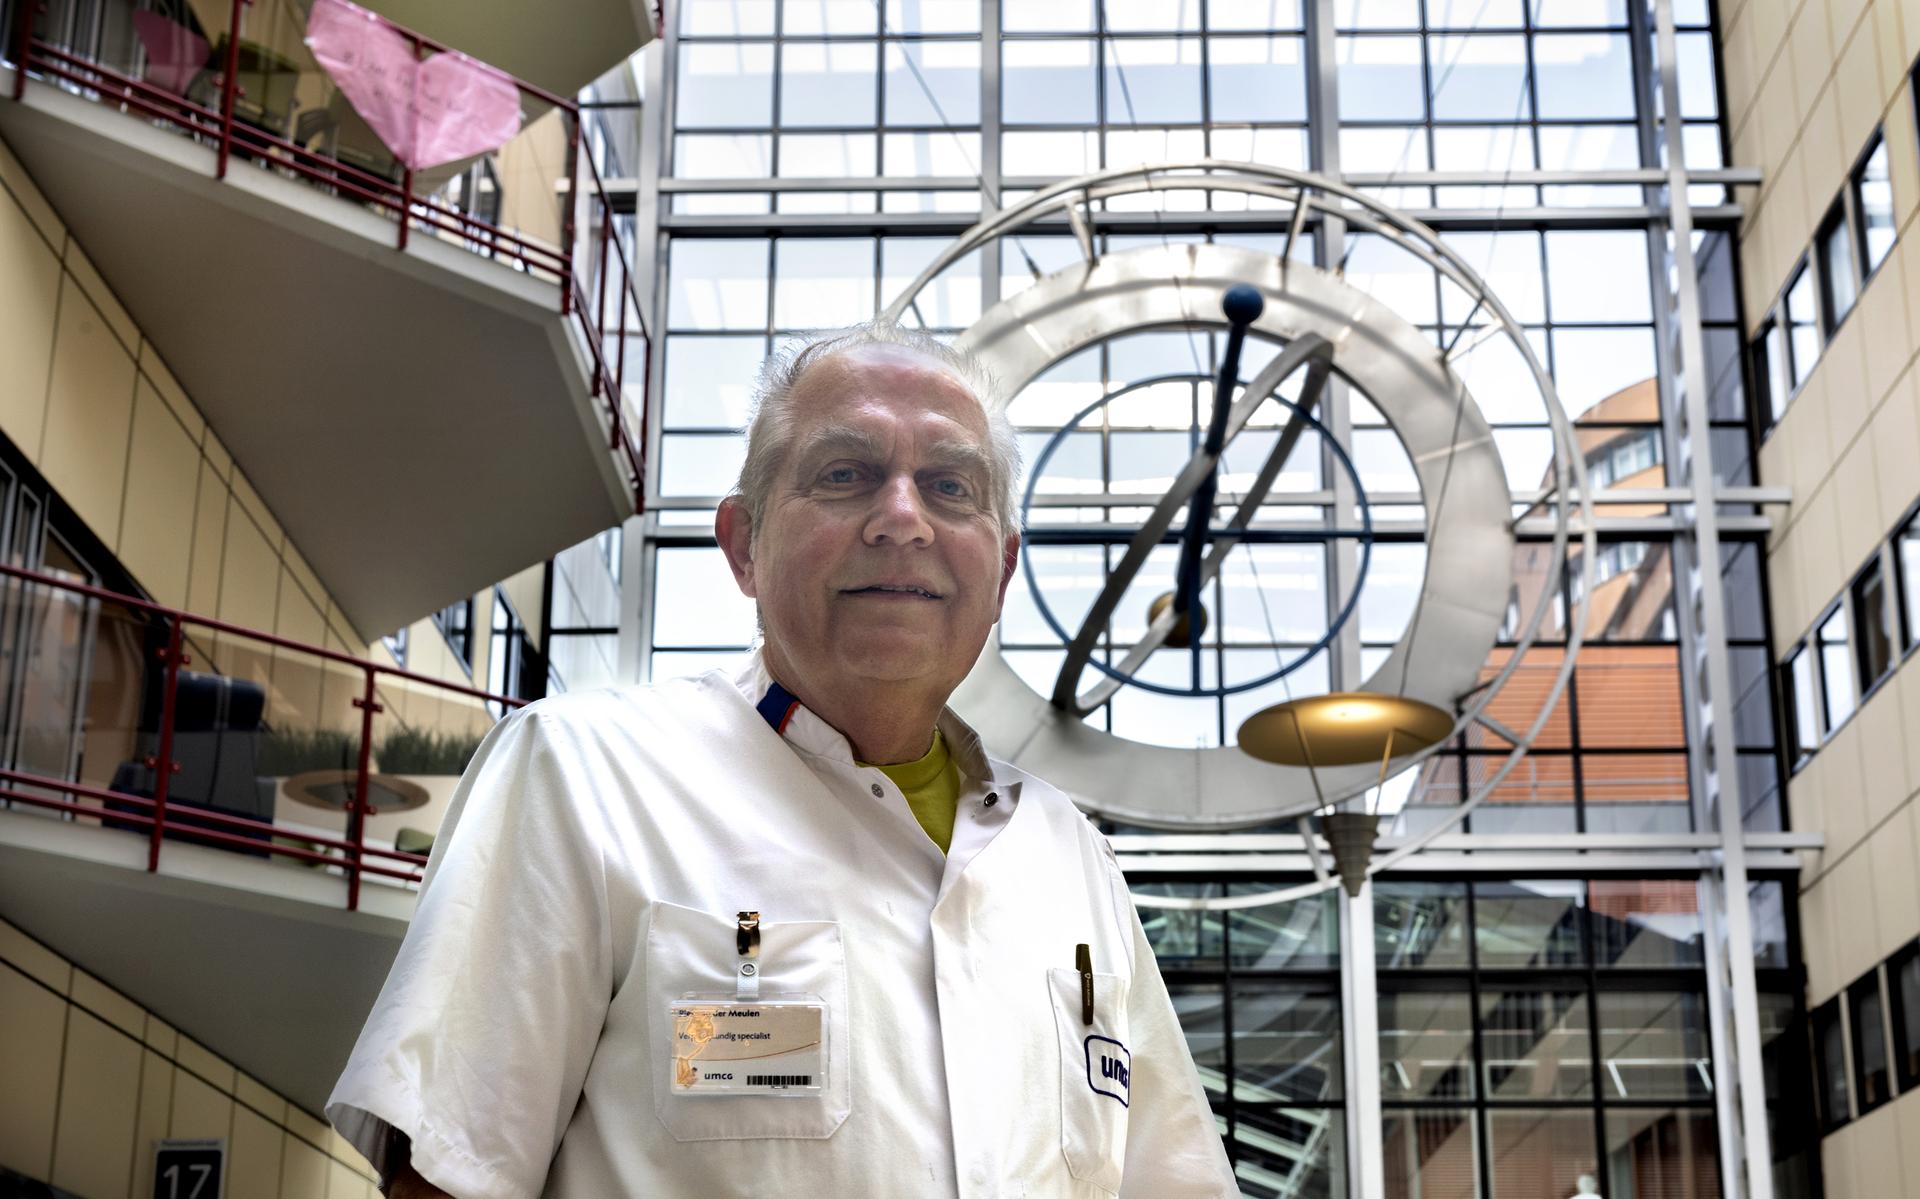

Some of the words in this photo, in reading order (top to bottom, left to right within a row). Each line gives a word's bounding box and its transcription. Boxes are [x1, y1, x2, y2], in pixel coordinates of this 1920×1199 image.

[728, 1009, 760, 1017] Meulen
[737, 1032, 771, 1041] specialist
[163, 1164, 212, 1199] 17
